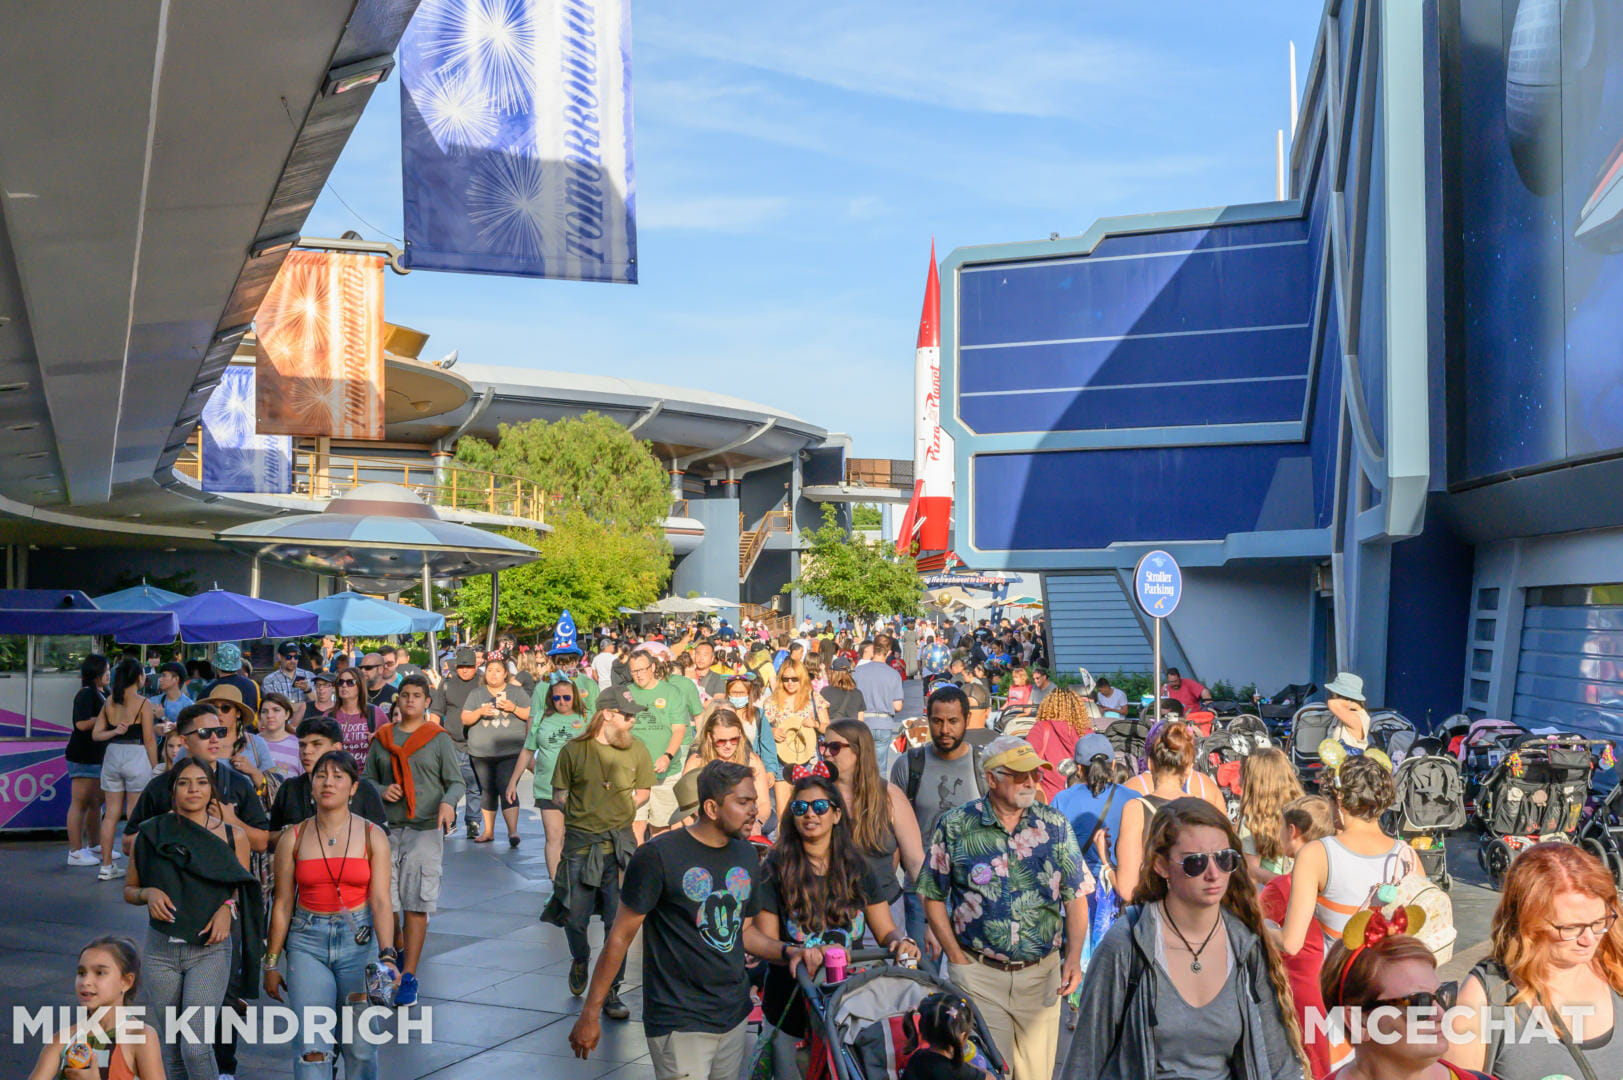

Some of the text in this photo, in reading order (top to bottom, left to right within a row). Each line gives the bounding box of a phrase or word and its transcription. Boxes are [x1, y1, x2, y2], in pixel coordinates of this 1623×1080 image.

[926, 362, 940, 463] Pizza Planet
[1145, 571, 1172, 583] Stroller
[1144, 583, 1174, 596] Parking
